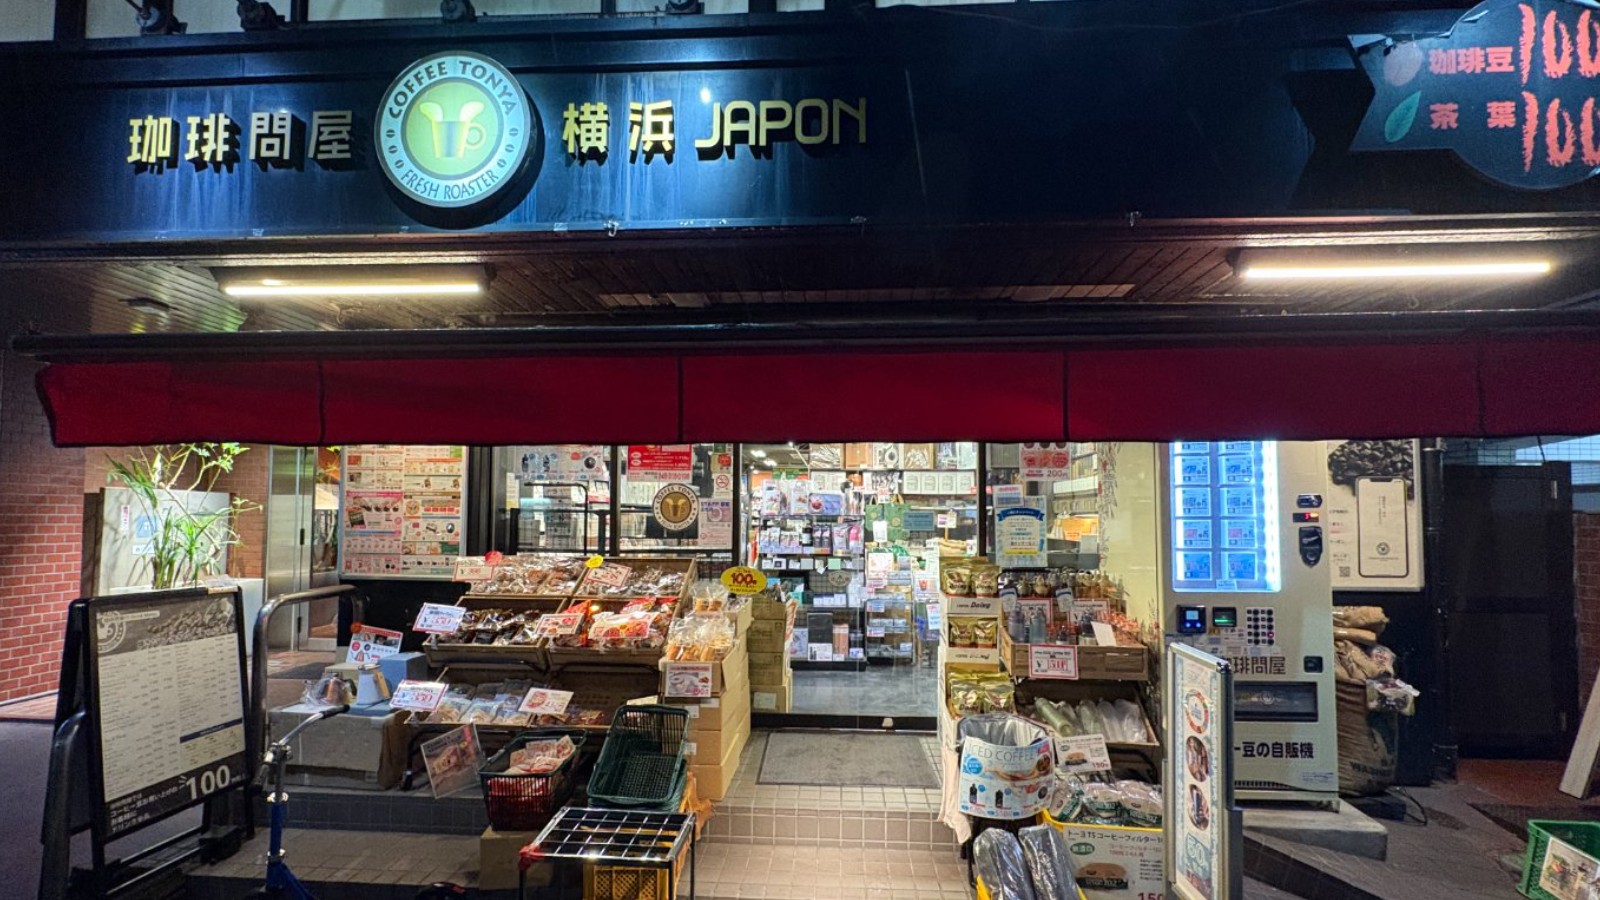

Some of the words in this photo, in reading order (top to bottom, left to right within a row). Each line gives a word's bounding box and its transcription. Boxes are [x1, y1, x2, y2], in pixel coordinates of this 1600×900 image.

[1429, 46, 1515, 74] 珈琲豆
[388, 61, 448, 120] COFFEE
[458, 60, 515, 116] TONYA
[127, 110, 353, 163] 珈琲問屋
[562, 100, 674, 153] 横浜
[694, 97, 867, 147] JAPON
[401, 169, 440, 199] FRESH
[443, 169, 499, 200] ROASTER
[995, 750, 1035, 762] COFFEE
[186, 764, 230, 800] 100
